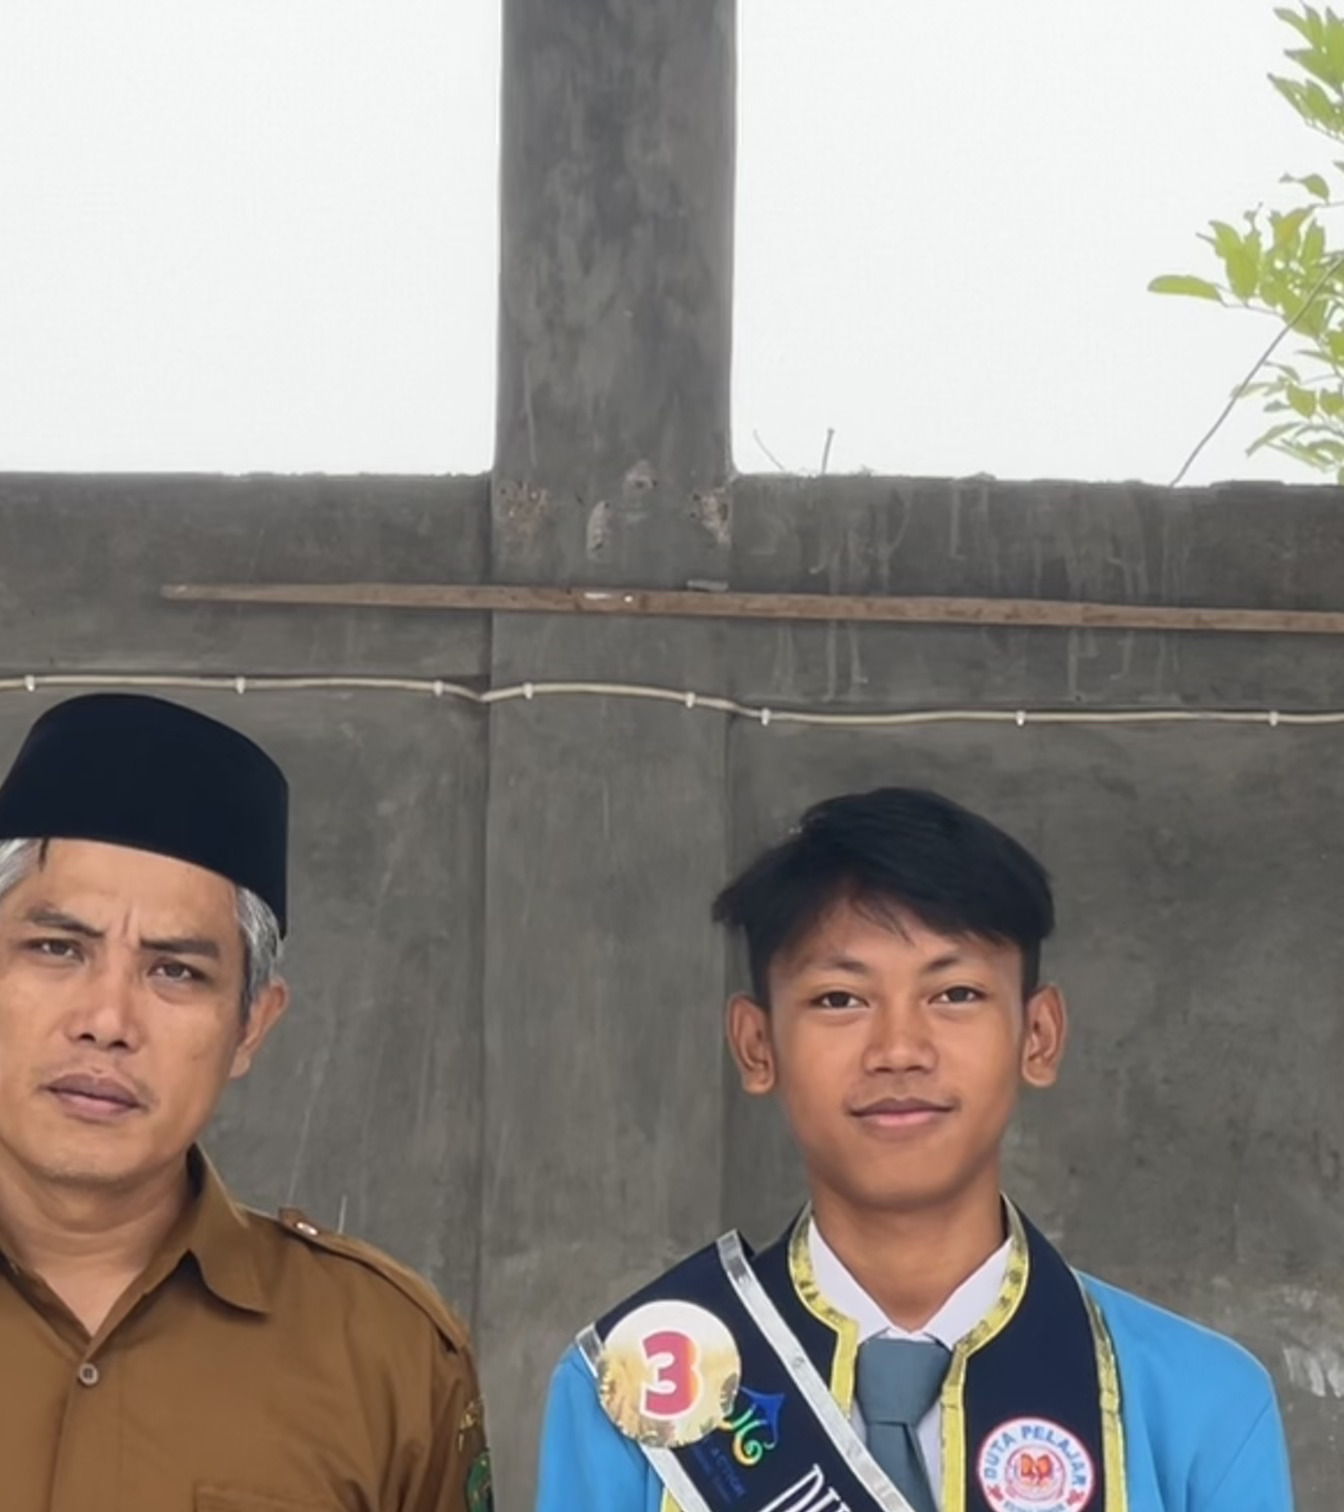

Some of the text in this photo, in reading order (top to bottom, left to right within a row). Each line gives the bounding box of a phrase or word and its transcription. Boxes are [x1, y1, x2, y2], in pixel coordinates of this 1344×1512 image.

[641, 1329, 701, 1419] 3
[984, 1425, 1087, 1487] DUTA PELAJAR
